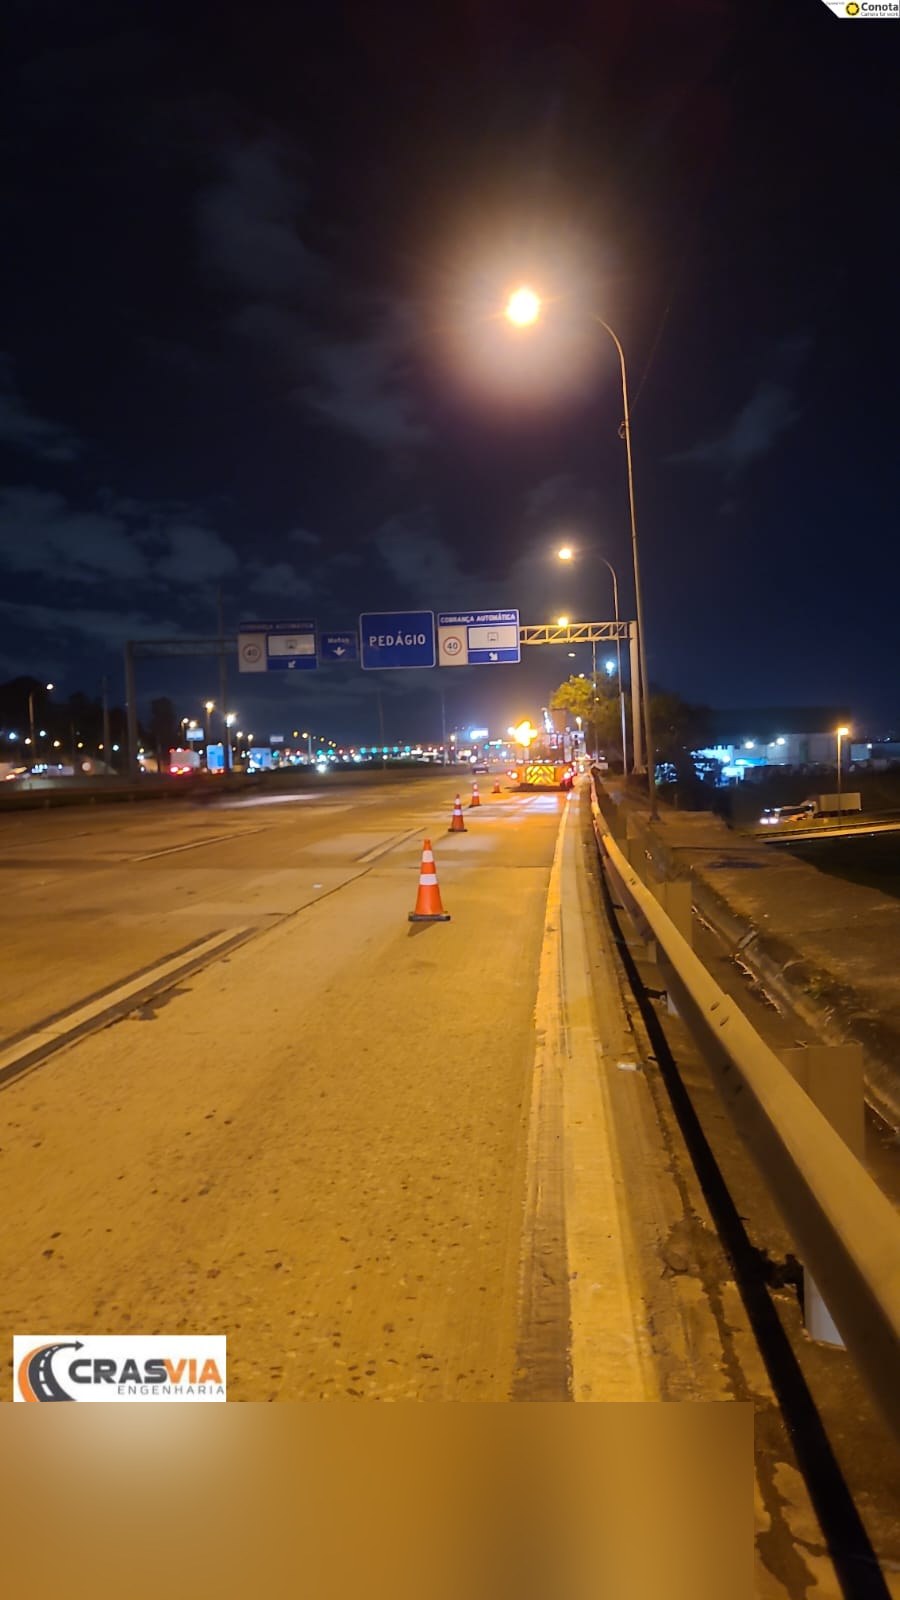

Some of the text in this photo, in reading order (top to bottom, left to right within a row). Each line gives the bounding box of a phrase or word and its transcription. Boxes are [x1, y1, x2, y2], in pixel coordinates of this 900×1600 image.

[476, 612, 516, 622] AUTOMÁTICA
[369, 630, 426, 647] PEDÁGIO
[446, 641, 458, 650] 40
[246, 648, 258, 657] 40
